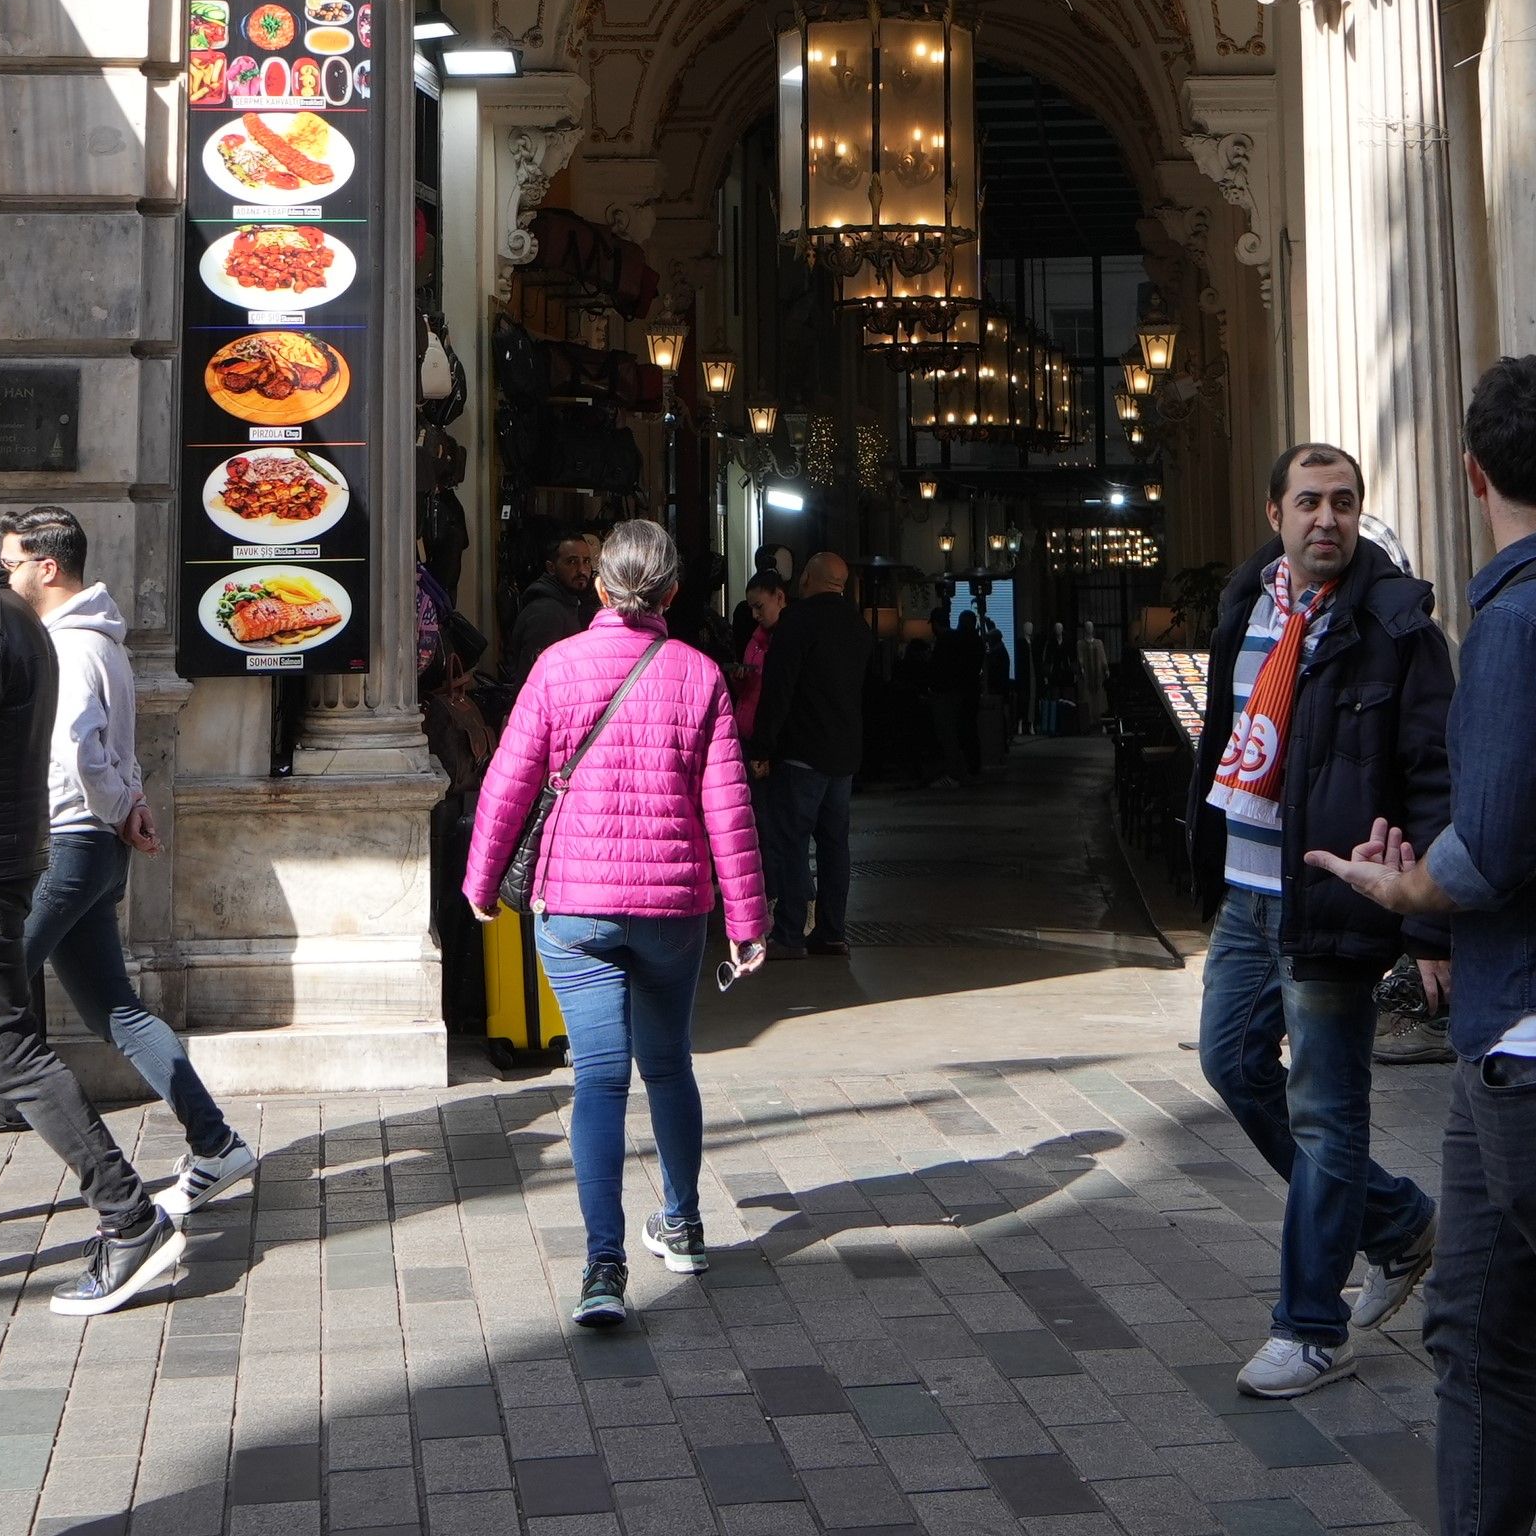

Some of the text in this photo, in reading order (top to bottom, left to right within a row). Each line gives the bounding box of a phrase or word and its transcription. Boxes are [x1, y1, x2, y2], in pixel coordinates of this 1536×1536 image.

[4, 386, 35, 398] HAN
[252, 428, 283, 439] PİRZOLA
[236, 547, 259, 557] TAVUK
[261, 547, 274, 559] ŞİŞ
[250, 657, 279, 667] SOMON
